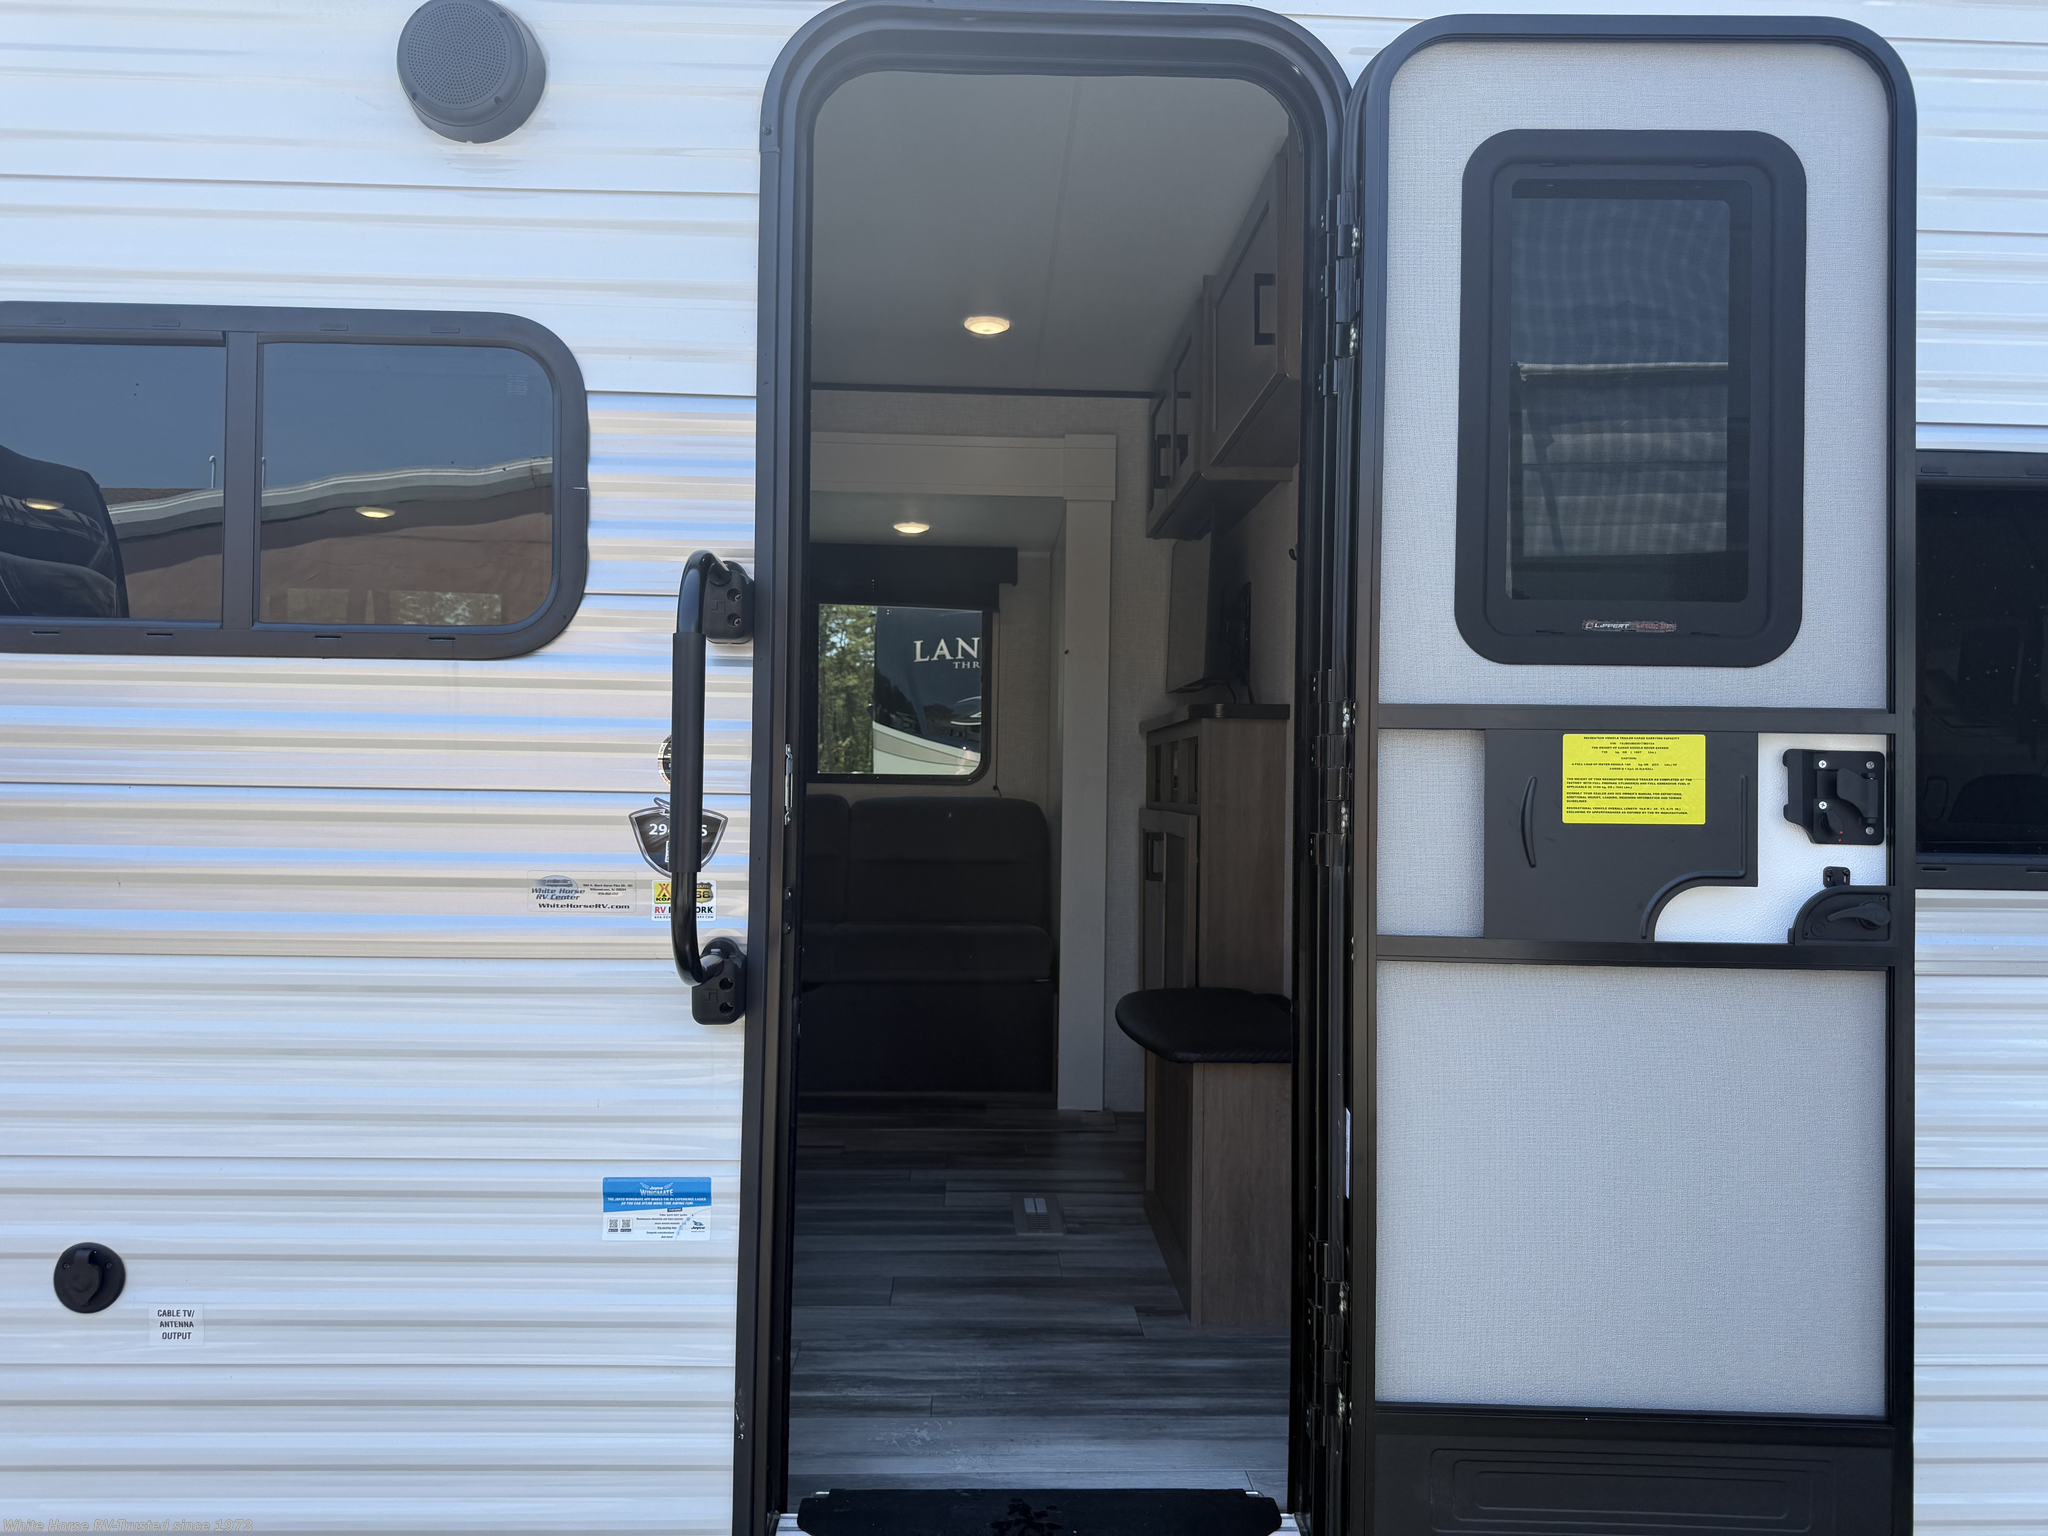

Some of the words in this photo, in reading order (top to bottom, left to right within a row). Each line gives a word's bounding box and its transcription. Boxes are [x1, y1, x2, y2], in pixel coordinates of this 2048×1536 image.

[157, 1309, 181, 1317] CABLE
[183, 1309, 195, 1317] TV/
[162, 1332, 192, 1340] OUTPUT
